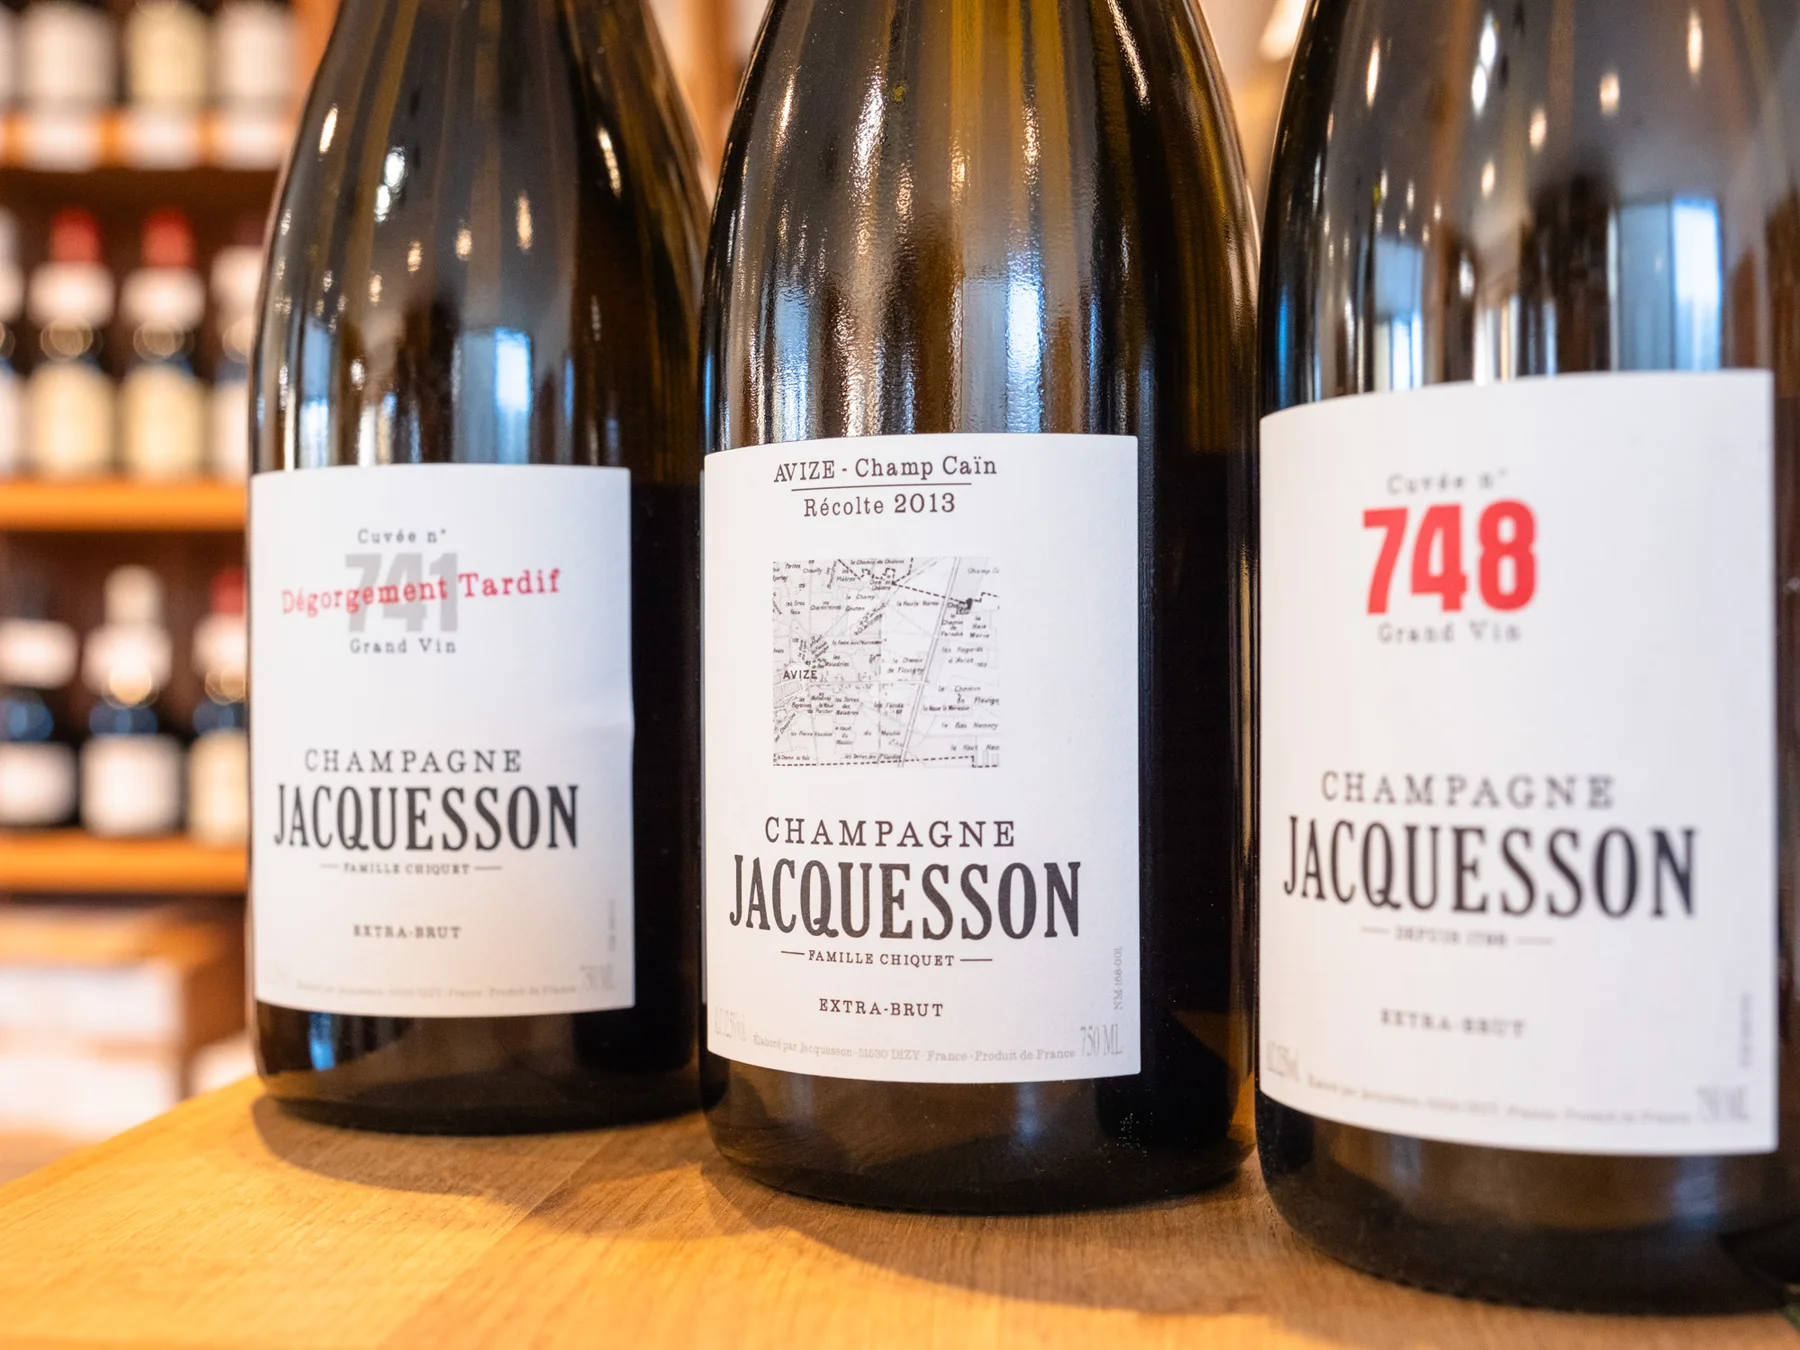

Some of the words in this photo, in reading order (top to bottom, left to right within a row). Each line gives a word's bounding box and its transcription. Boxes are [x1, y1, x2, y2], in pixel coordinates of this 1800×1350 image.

[774, 460, 835, 483] AVIZE
[855, 457, 933, 480] Champ
[942, 456, 997, 476] Caïn
[1387, 473, 1467, 496] Cuvée
[803, 497, 884, 518] Récolte
[894, 494, 956, 514] 2013
[358, 528, 417, 545] Cuvée
[1363, 499, 1538, 615] 748
[282, 577, 448, 617] Dégorgement
[458, 568, 562, 599] Tardif
[344, 552, 458, 632] 741
[1378, 620, 1455, 644] Grand
[1470, 619, 1521, 642] Vin
[350, 638, 408, 655] Grand
[418, 639, 457, 653] Vin
[783, 670, 818, 680] AVIZE
[305, 749, 522, 773] CHAMPAGNE
[1322, 770, 1614, 810] CHAMPAGNE
[274, 784, 579, 852] JACQUESSON
[765, 816, 1016, 848] CHAMPAGNE
[343, 861, 400, 875] FAMILLE
[405, 862, 471, 876] CHIQUET
[1283, 815, 1698, 920] JACQUESSON
[730, 854, 1081, 941] JACQUESSON
[353, 923, 461, 940] EXTRA-BRUT
[809, 950, 874, 966] FAMILLE
[879, 952, 955, 968] CHIQUET
[819, 999, 944, 1018] EXTRA-BRUT
[800, 1042, 853, 1057] Jacquesson
[927, 1050, 967, 1061] France
[974, 1050, 1017, 1061] Produit
[1020, 1050, 1034, 1060] de
[1036, 1049, 1075, 1060] France
[1080, 1026, 1100, 1057] 750
[1103, 1024, 1123, 1057] ML
